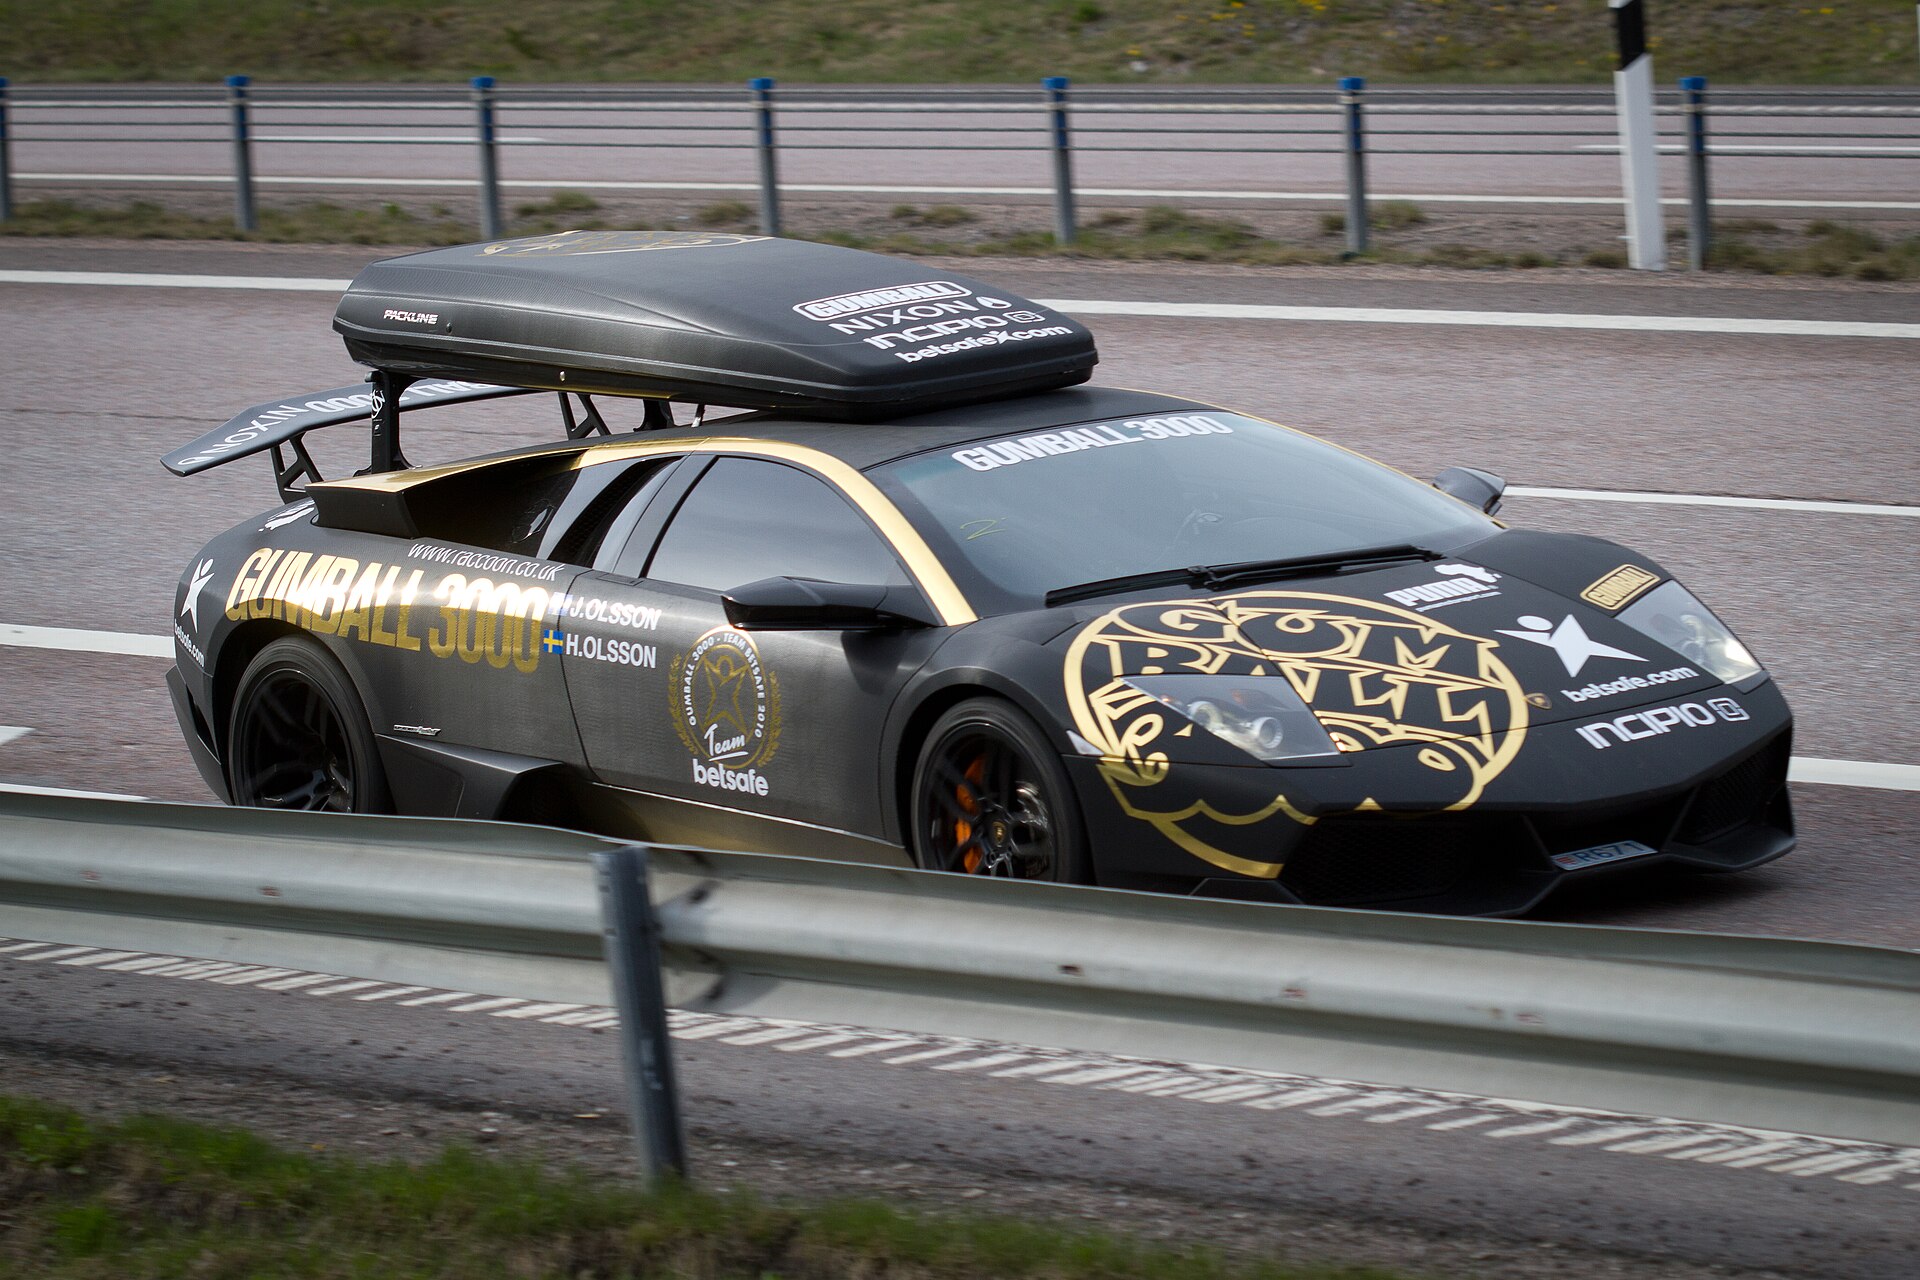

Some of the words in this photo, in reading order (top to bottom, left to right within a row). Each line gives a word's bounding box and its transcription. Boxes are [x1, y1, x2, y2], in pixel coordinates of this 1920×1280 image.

[383, 309, 439, 325] PACKLINE
[804, 282, 963, 318] GUMBALL
[828, 300, 980, 336] NIXON
[200, 405, 310, 454] NIXON
[951, 424, 1146, 472] GUMBALL
[1122, 415, 1235, 440] 3000
[407, 543, 566, 582] www.raccoon.co.uk
[1383, 577, 1491, 607] PUMA
[225, 547, 425, 652] GUMBALL
[428, 573, 550, 674] 3000
[569, 596, 662, 631] J.OLSSON
[566, 633, 657, 669] H.OLSSON
[692, 636, 715, 661] 3000
[723, 633, 746, 651] TEAM
[744, 647, 766, 699] BETSAFE
[1560, 666, 1699, 703] betsafe.com
[683, 663, 697, 726] GUMBALL
[754, 704, 767, 738] 2010
[1575, 702, 1717, 750] INCIPIO
[704, 723, 746, 757] Team
[692, 758, 769, 796] betsafe
